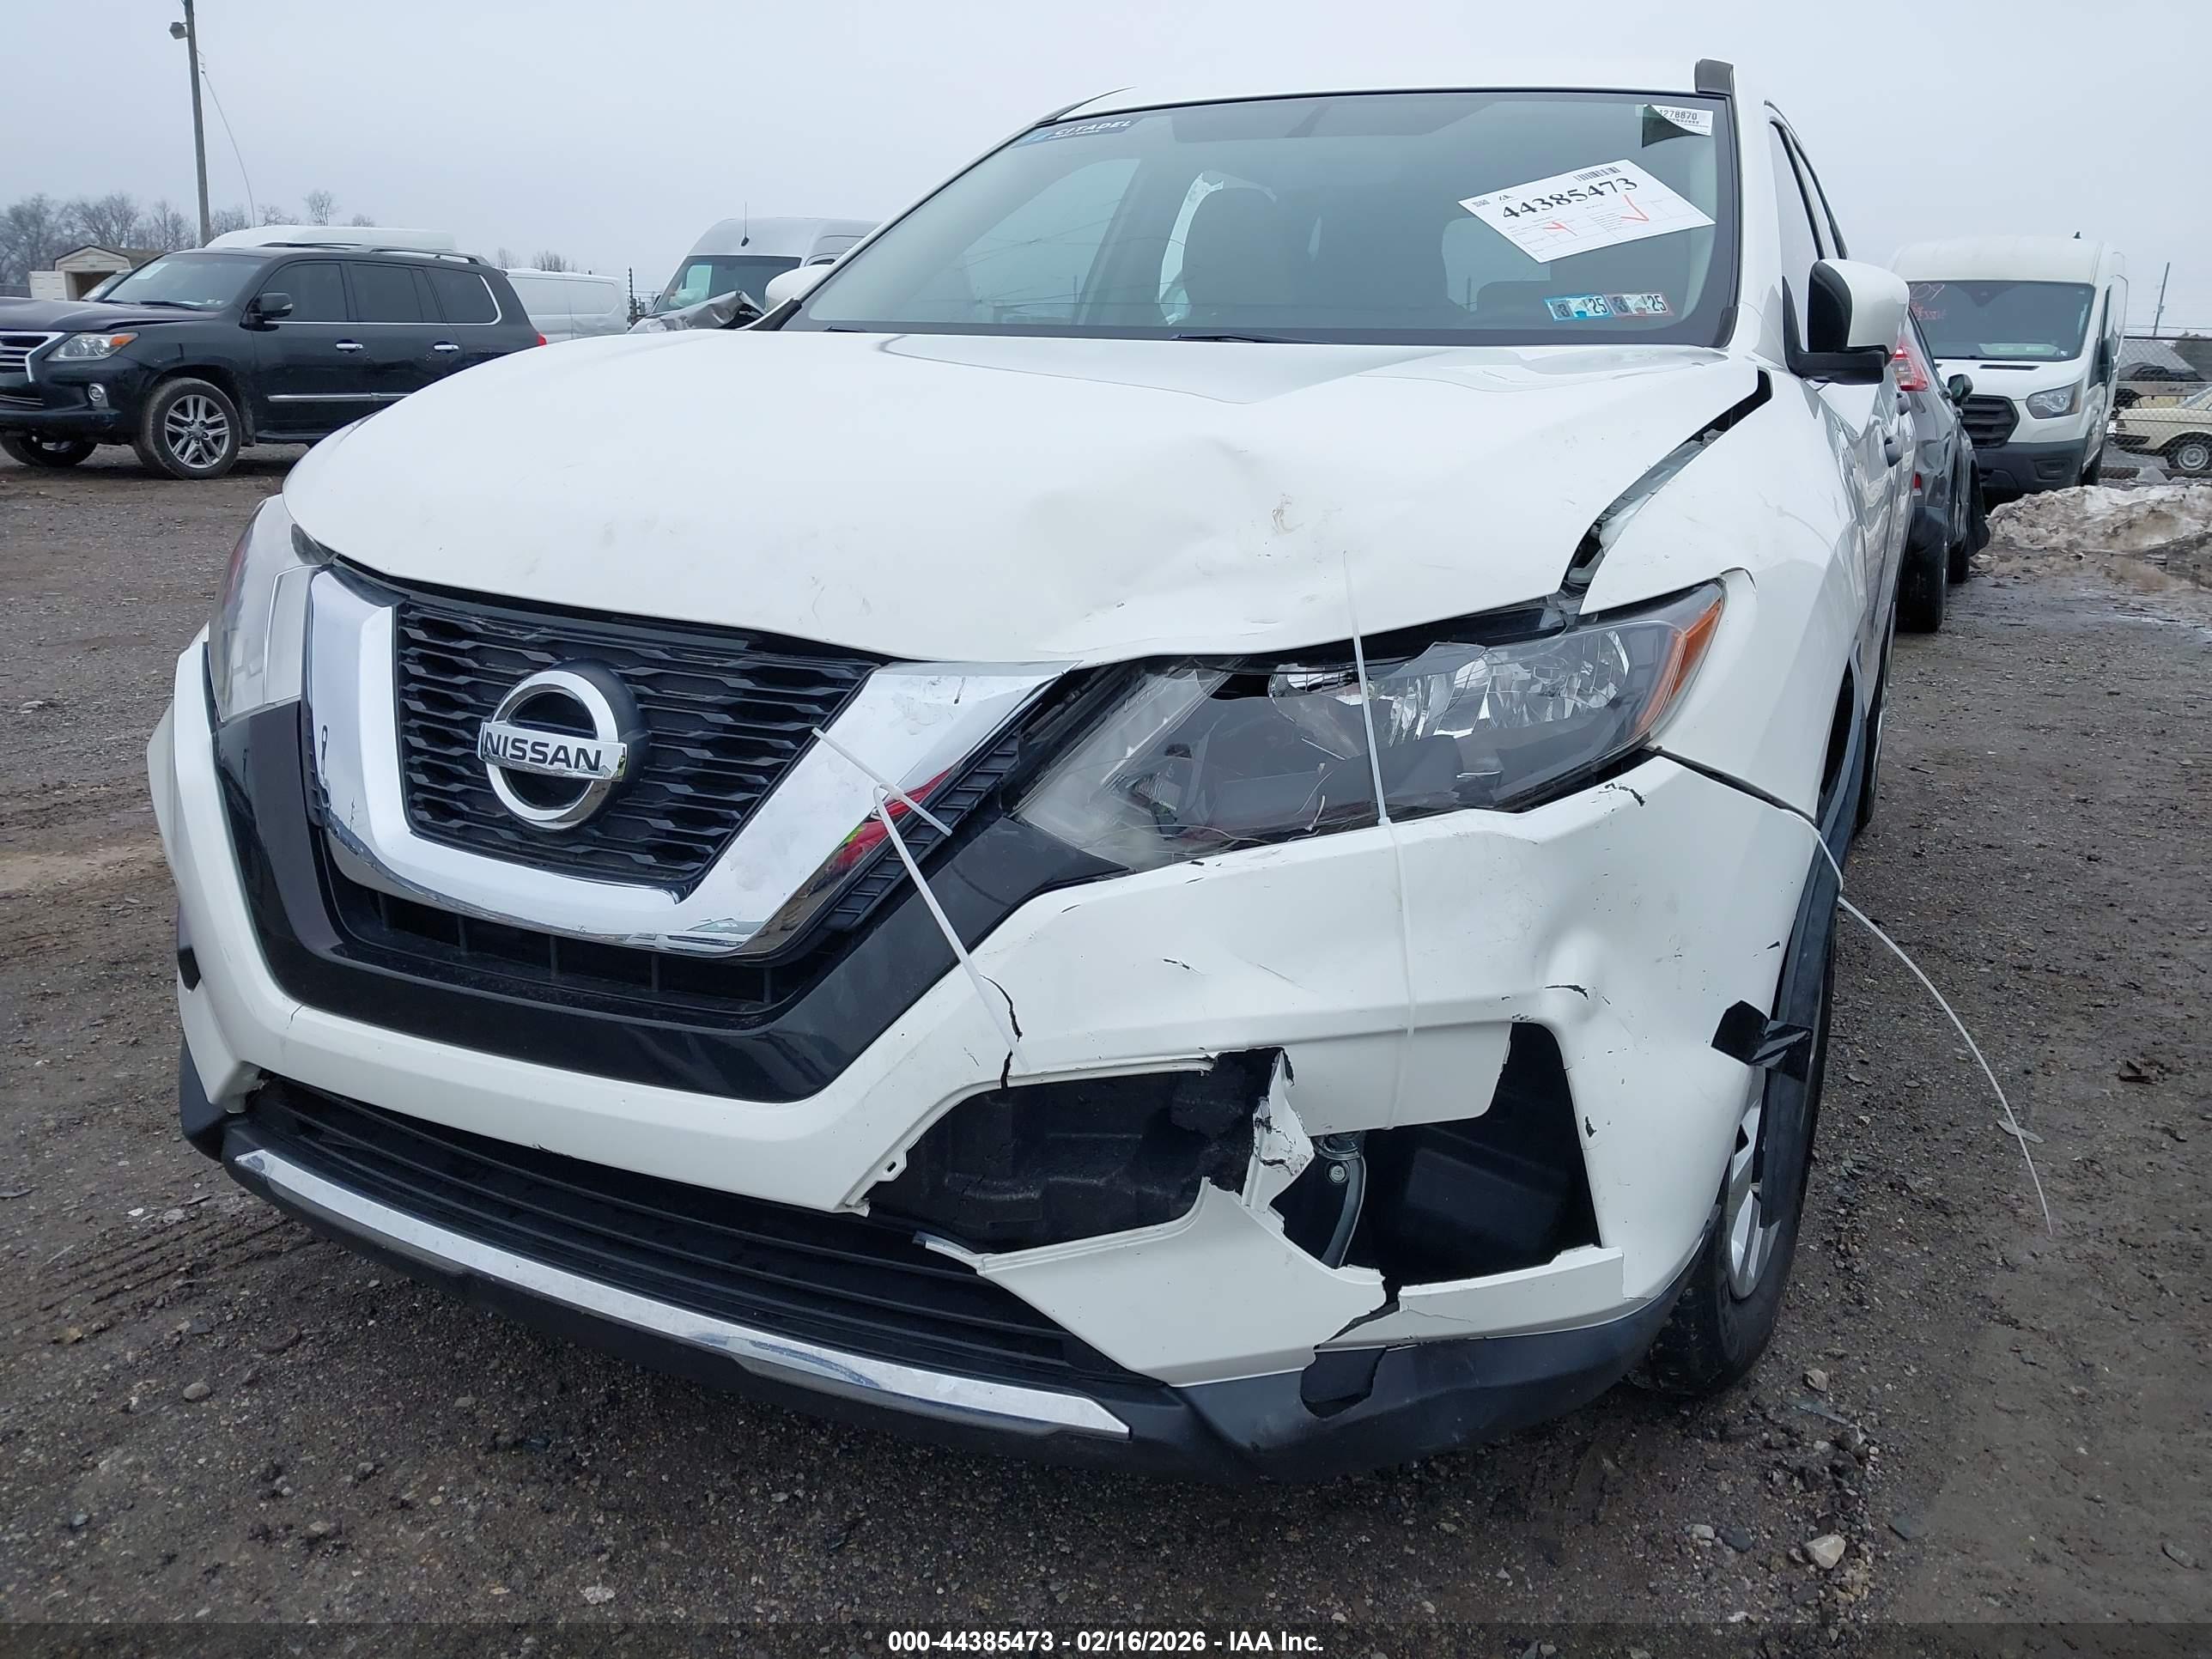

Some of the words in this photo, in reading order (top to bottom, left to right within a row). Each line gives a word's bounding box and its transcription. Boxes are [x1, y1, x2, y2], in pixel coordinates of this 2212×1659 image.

[1054, 120, 1132, 136] CITADEL
[1503, 177, 1638, 219] 44385473
[1589, 297, 1608, 313] 25
[1647, 295, 1667, 312] 25
[485, 732, 602, 771] NISSAN
